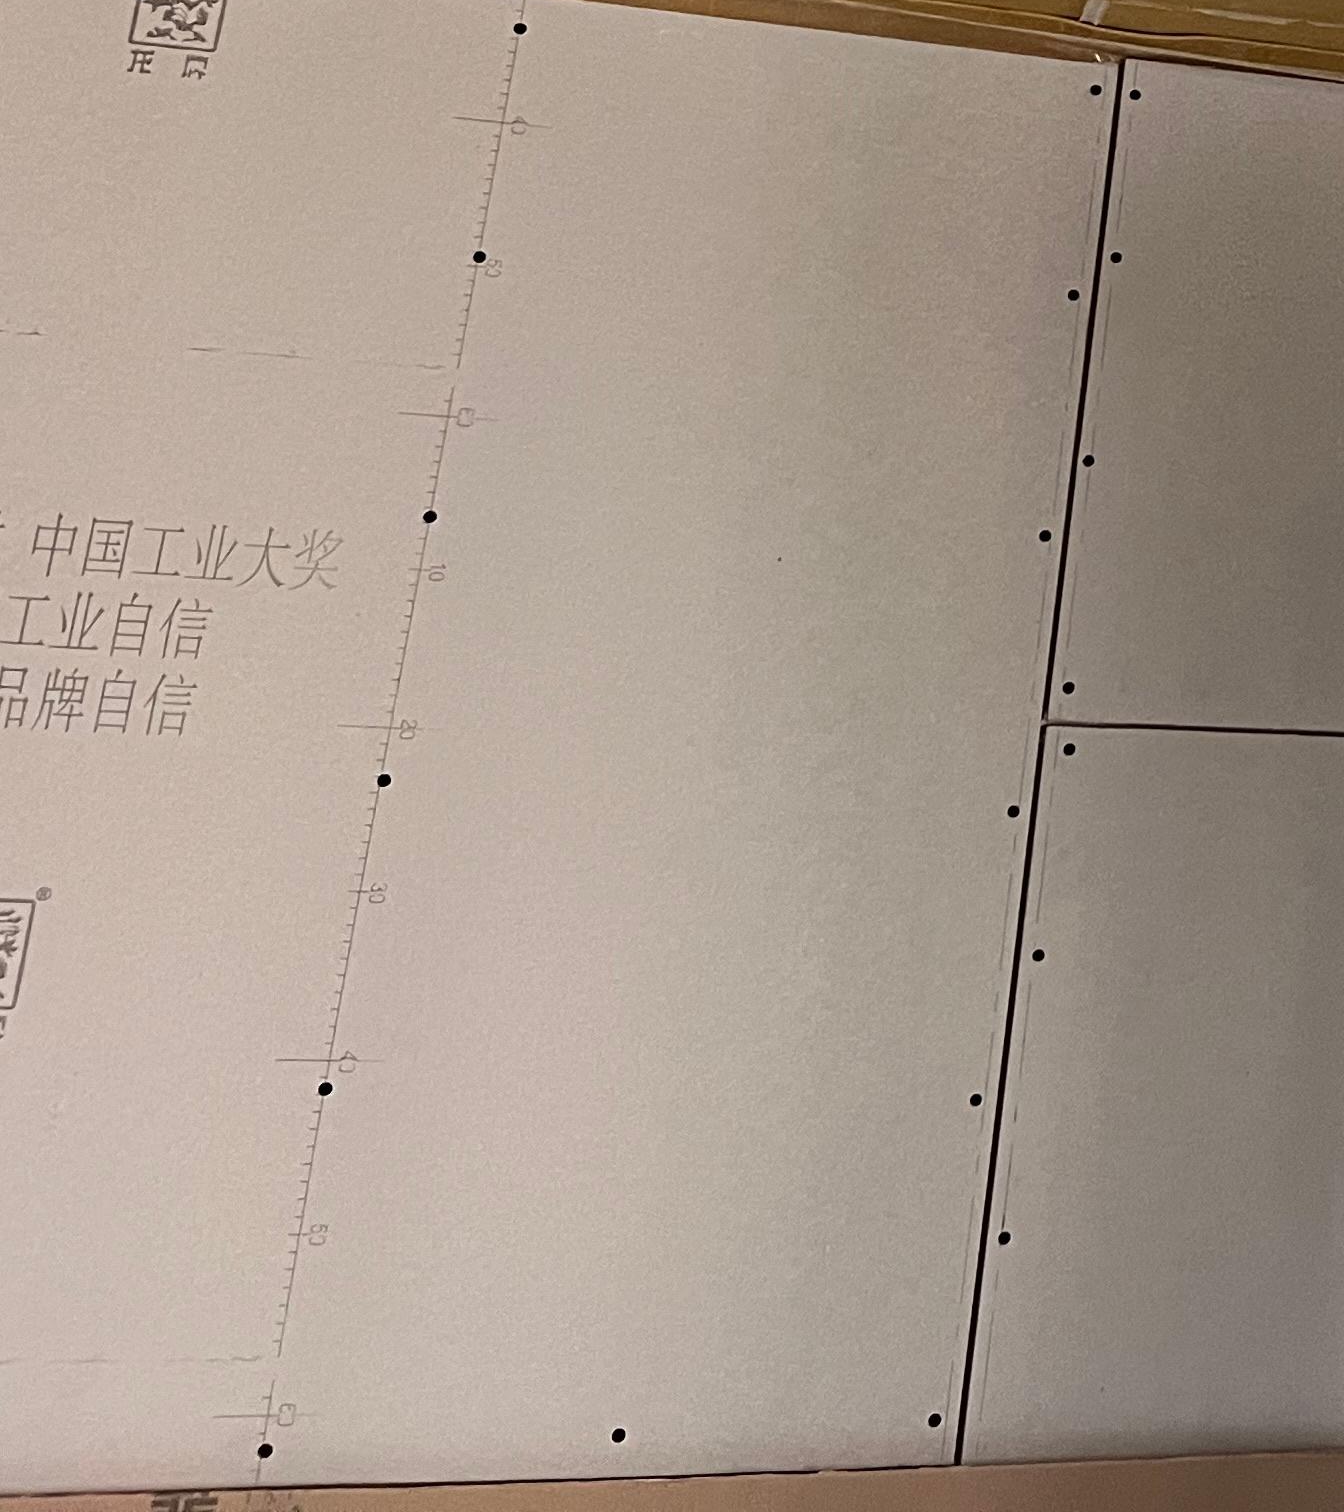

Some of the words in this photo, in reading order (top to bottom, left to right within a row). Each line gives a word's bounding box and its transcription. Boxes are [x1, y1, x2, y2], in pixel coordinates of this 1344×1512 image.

[31, 513, 344, 590] 中国工业大奖
[428, 563, 447, 582] 10
[0, 592, 214, 660] 工业自信
[0, 667, 198, 737] 品牌自信
[399, 719, 417, 740] 20
[368, 882, 388, 905] 30
